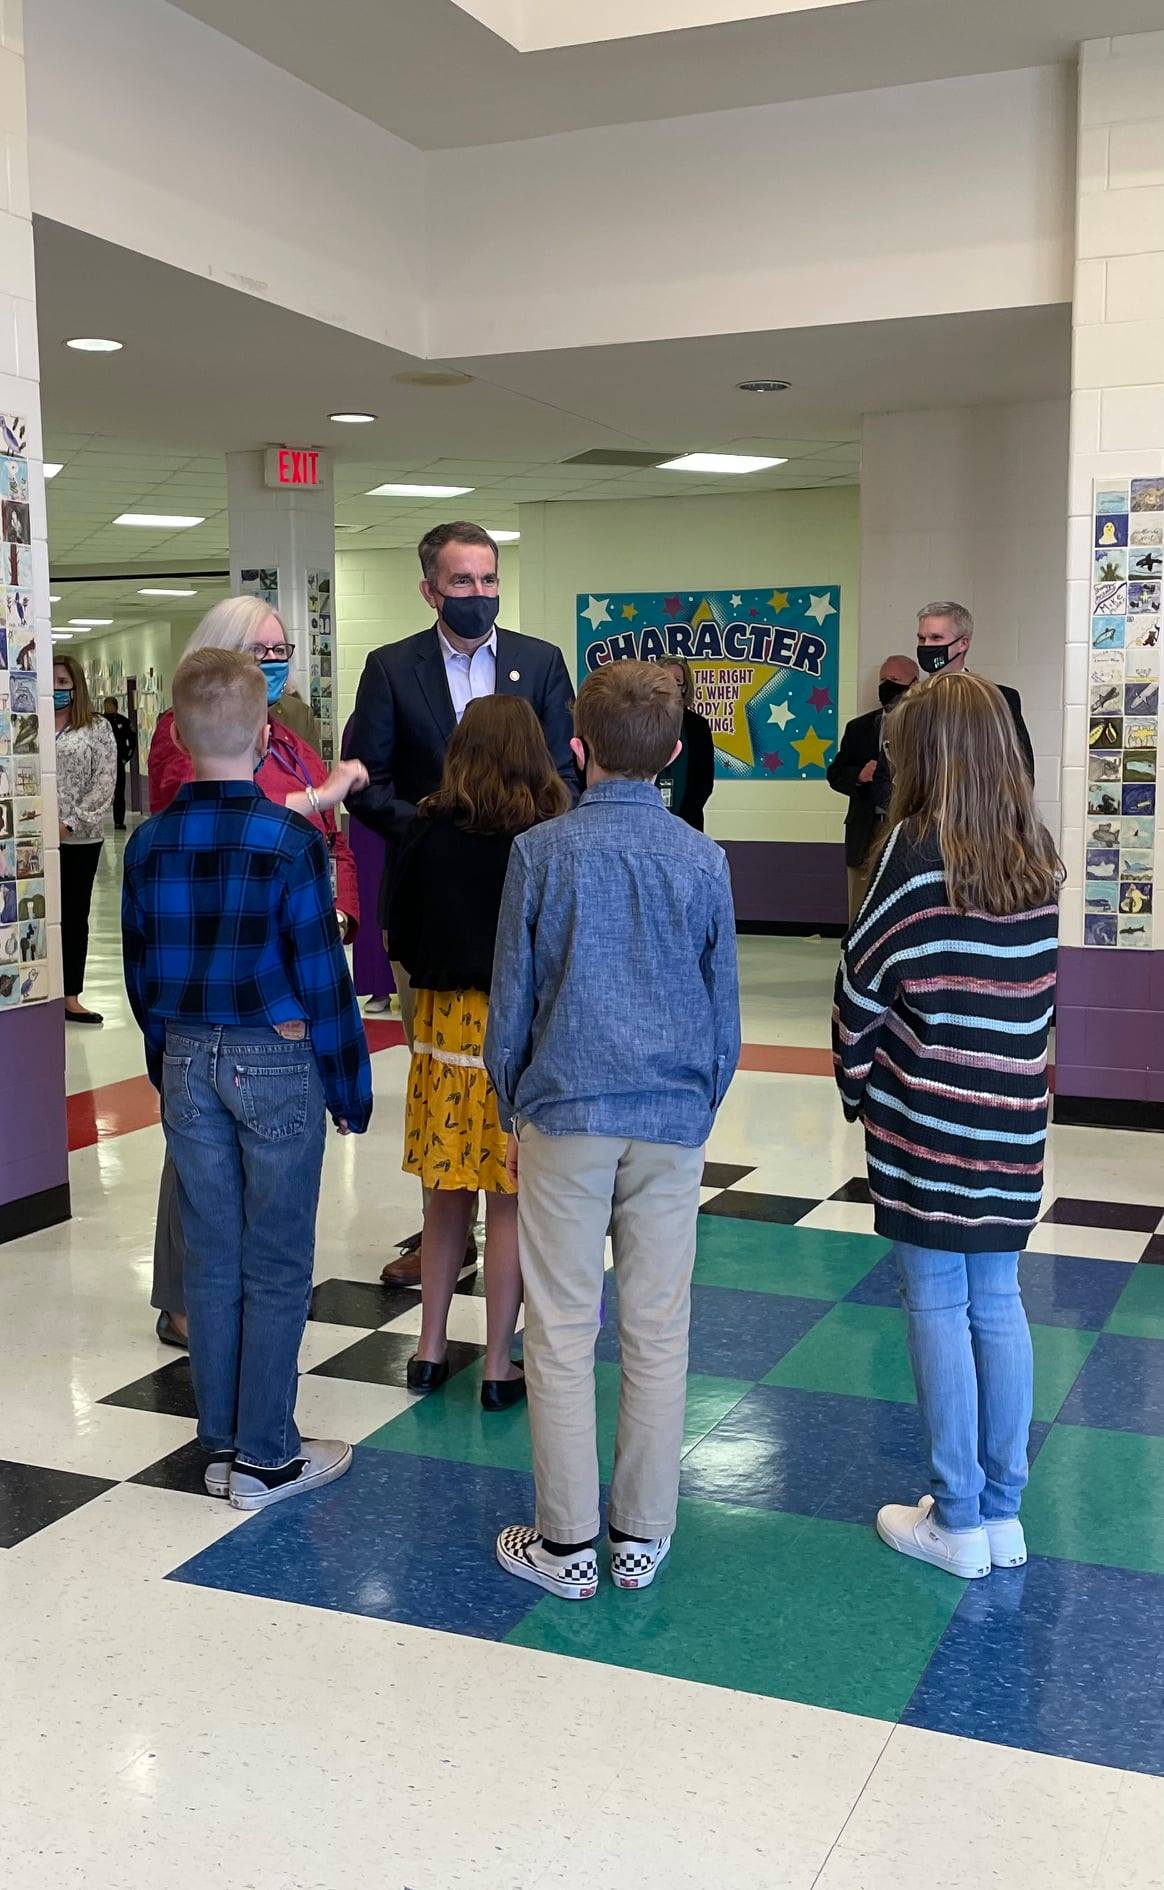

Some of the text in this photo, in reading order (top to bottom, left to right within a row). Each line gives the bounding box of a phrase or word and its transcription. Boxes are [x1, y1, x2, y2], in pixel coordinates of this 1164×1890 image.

[278, 449, 319, 485] EXIT
[586, 622, 826, 676] CHARACTER
[694, 669, 754, 684] THE RIGHT
[706, 685, 739, 700] WHEN
[724, 701, 734, 716] IS
[709, 717, 735, 733] ING!
